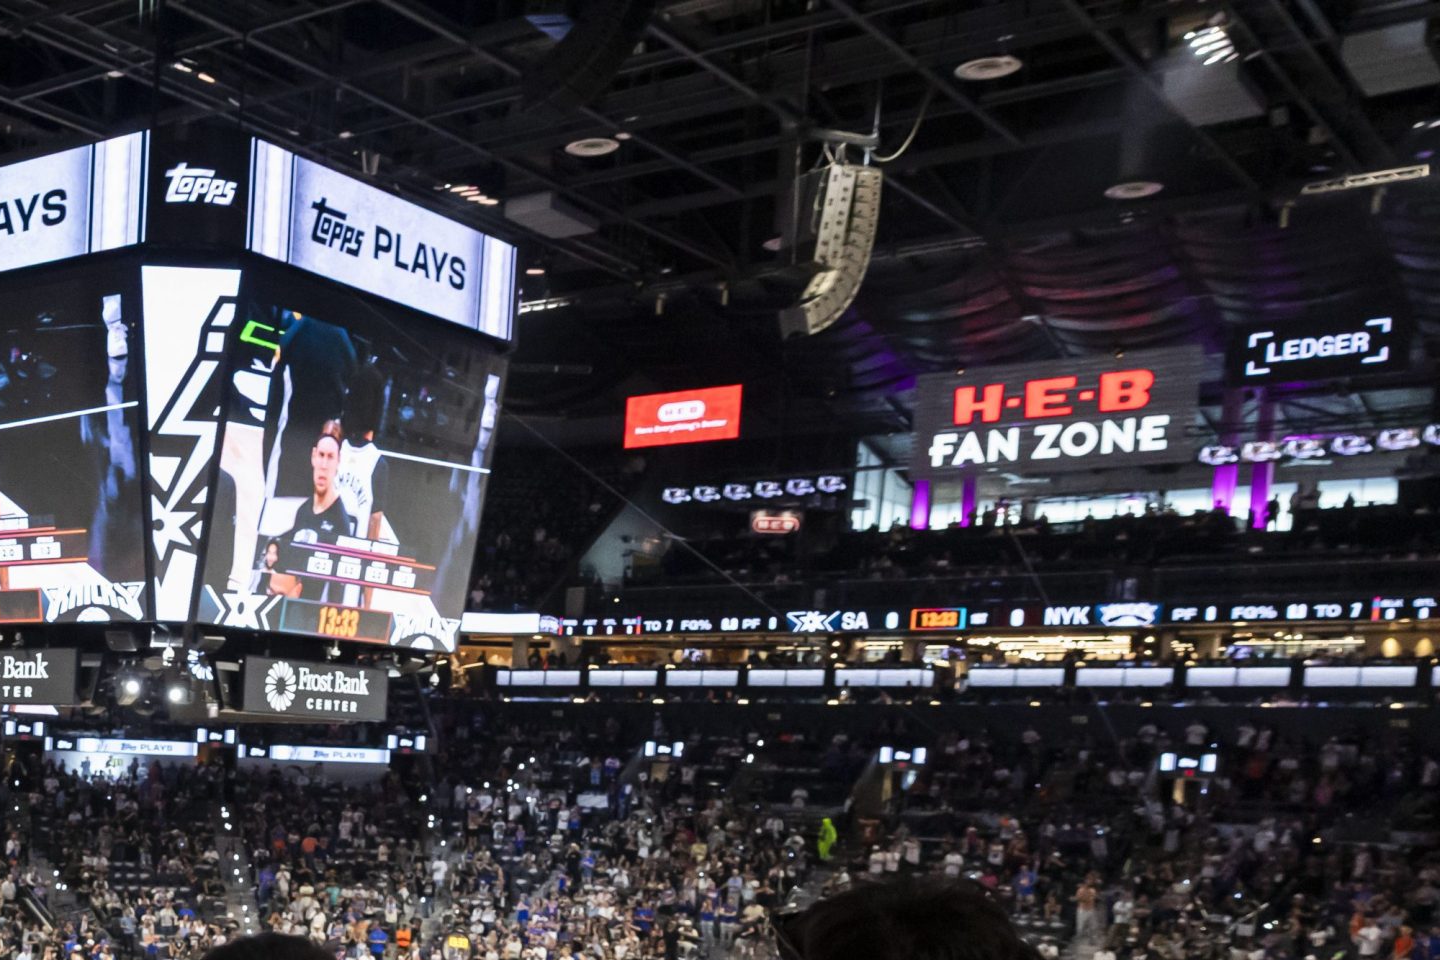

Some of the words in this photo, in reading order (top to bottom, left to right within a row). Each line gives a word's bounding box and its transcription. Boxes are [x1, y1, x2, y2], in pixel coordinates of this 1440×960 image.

[373, 225, 467, 291] PLAYS
[1265, 331, 1371, 363] LEDGER
[928, 426, 1020, 468] FAN
[1033, 415, 1171, 460] ZONE
[45, 581, 146, 622] KNICKS
[1171, 607, 1198, 621] PF
[1231, 606, 1278, 620] FG%
[1313, 604, 1342, 618] TO
[318, 606, 359, 637] 13:33
[644, 620, 661, 631] TO
[742, 618, 761, 630] PF
[841, 612, 869, 630] SA
[1043, 606, 1090, 625] NYK
[3, 652, 49, 679] Bank
[298, 666, 334, 693] Frost
[334, 670, 370, 695] Bank
[306, 697, 358, 713] CENTER
[140, 743, 173, 752] PLAYS
[332, 751, 366, 759] PLAYS
